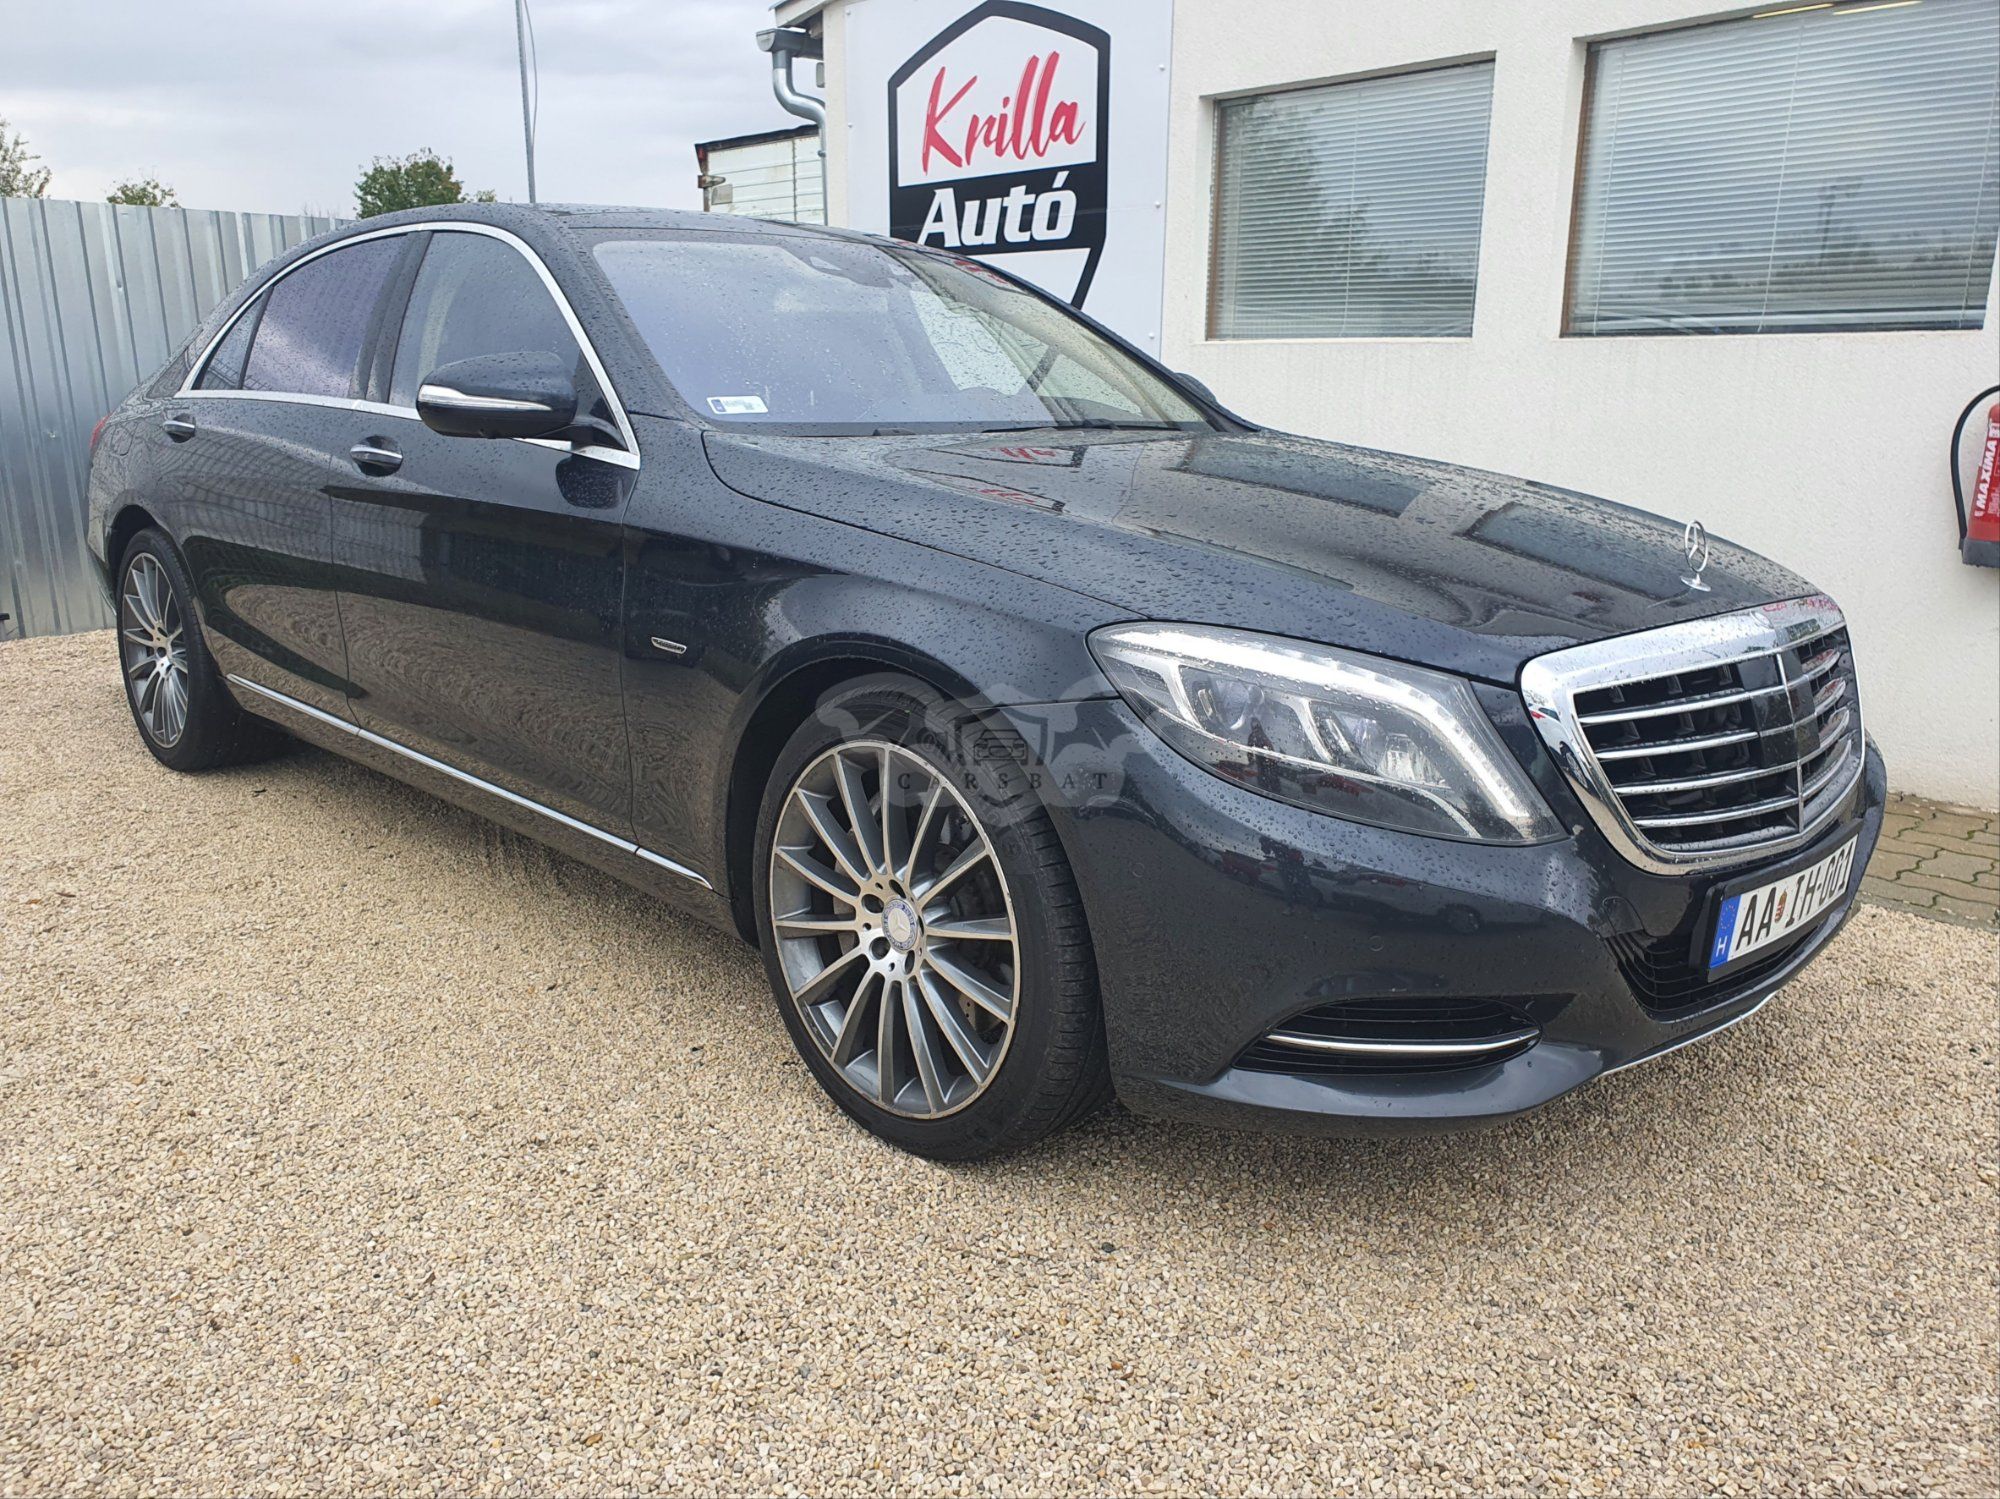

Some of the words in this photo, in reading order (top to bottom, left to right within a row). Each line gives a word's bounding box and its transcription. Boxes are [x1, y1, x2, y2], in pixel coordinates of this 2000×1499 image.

[921, 50, 1086, 176] Krilla
[916, 170, 1078, 248] Autó
[1976, 439, 1998, 510] MAXIMA
[1715, 935, 1728, 958] H
[1735, 886, 1777, 951] AA
